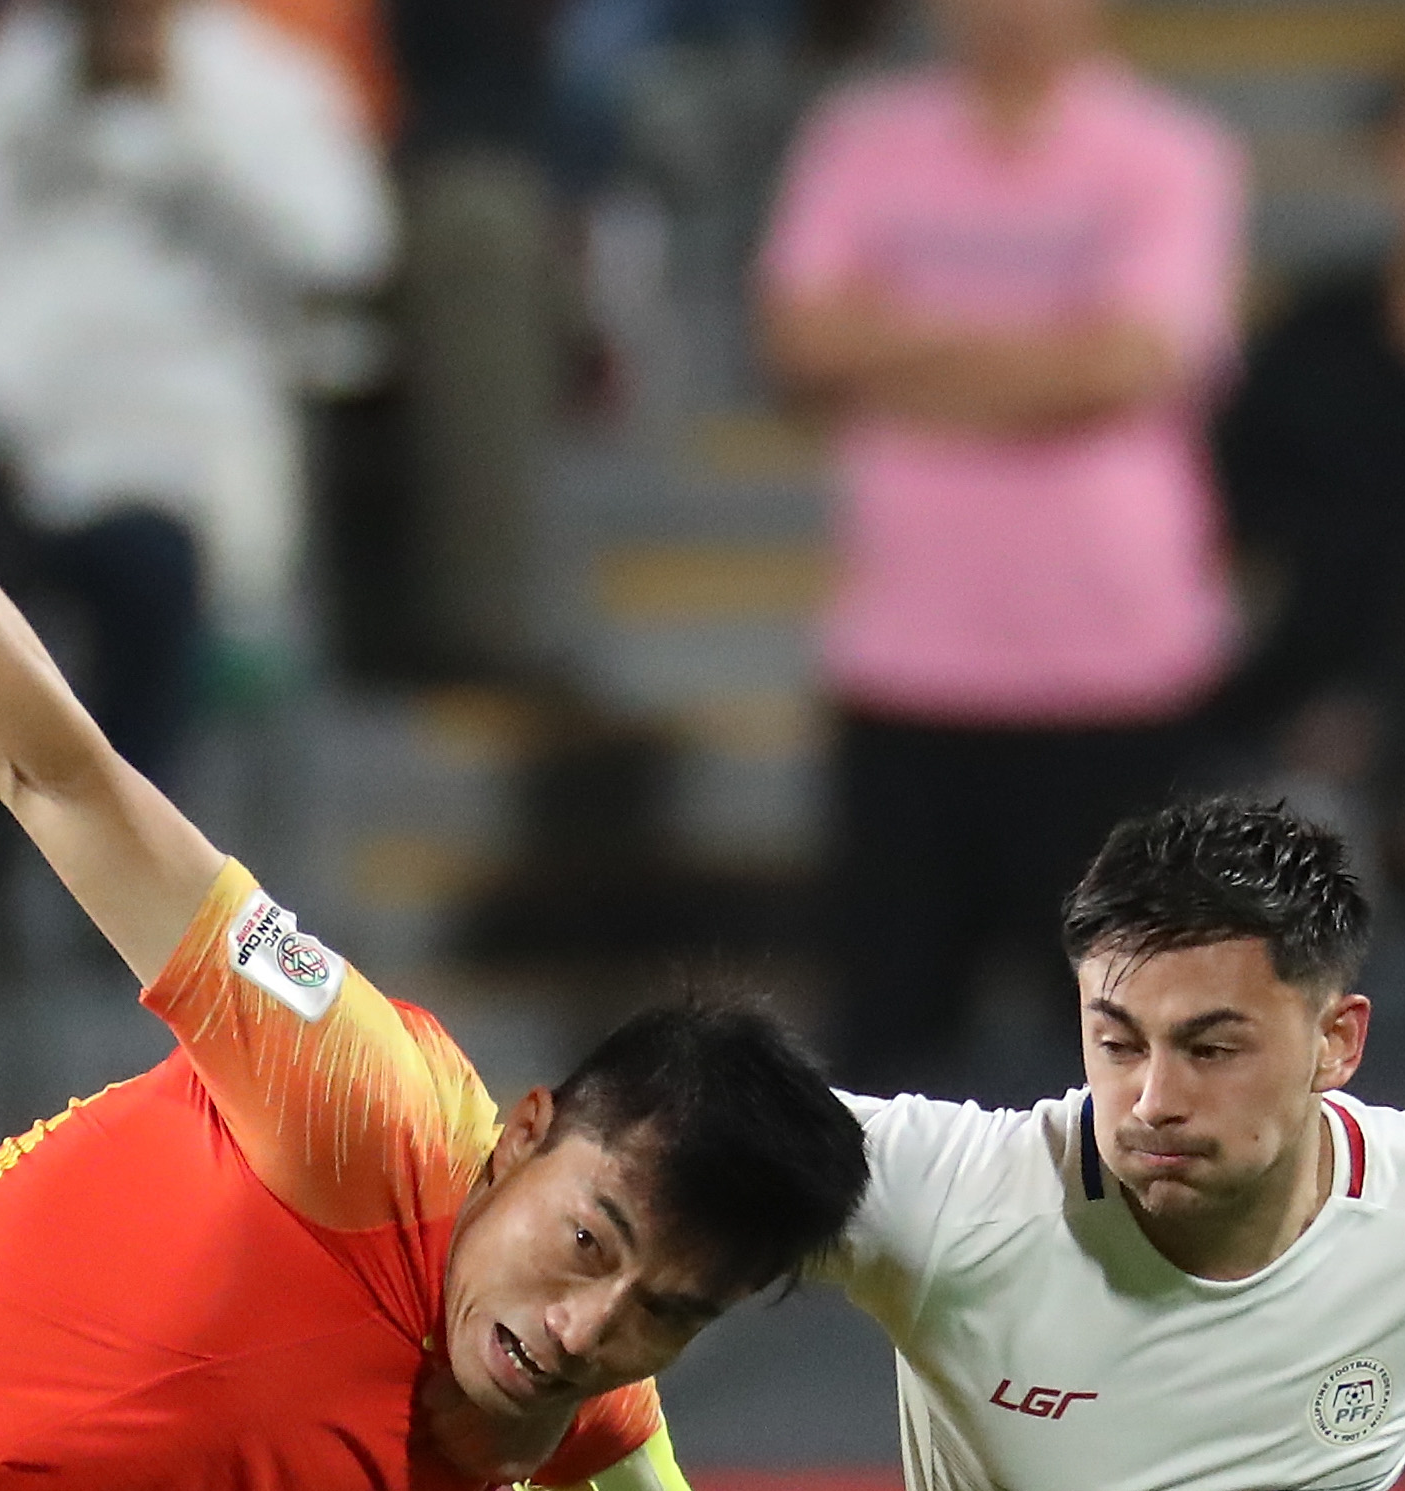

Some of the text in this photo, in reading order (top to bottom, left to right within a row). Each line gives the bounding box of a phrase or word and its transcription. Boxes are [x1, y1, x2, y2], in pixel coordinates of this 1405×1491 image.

[265, 925, 282, 947] AFC
[238, 934, 261, 965] CUP
[1329, 1360, 1378, 1382] FOOTBALL
[1335, 1403, 1375, 1424] PFF
